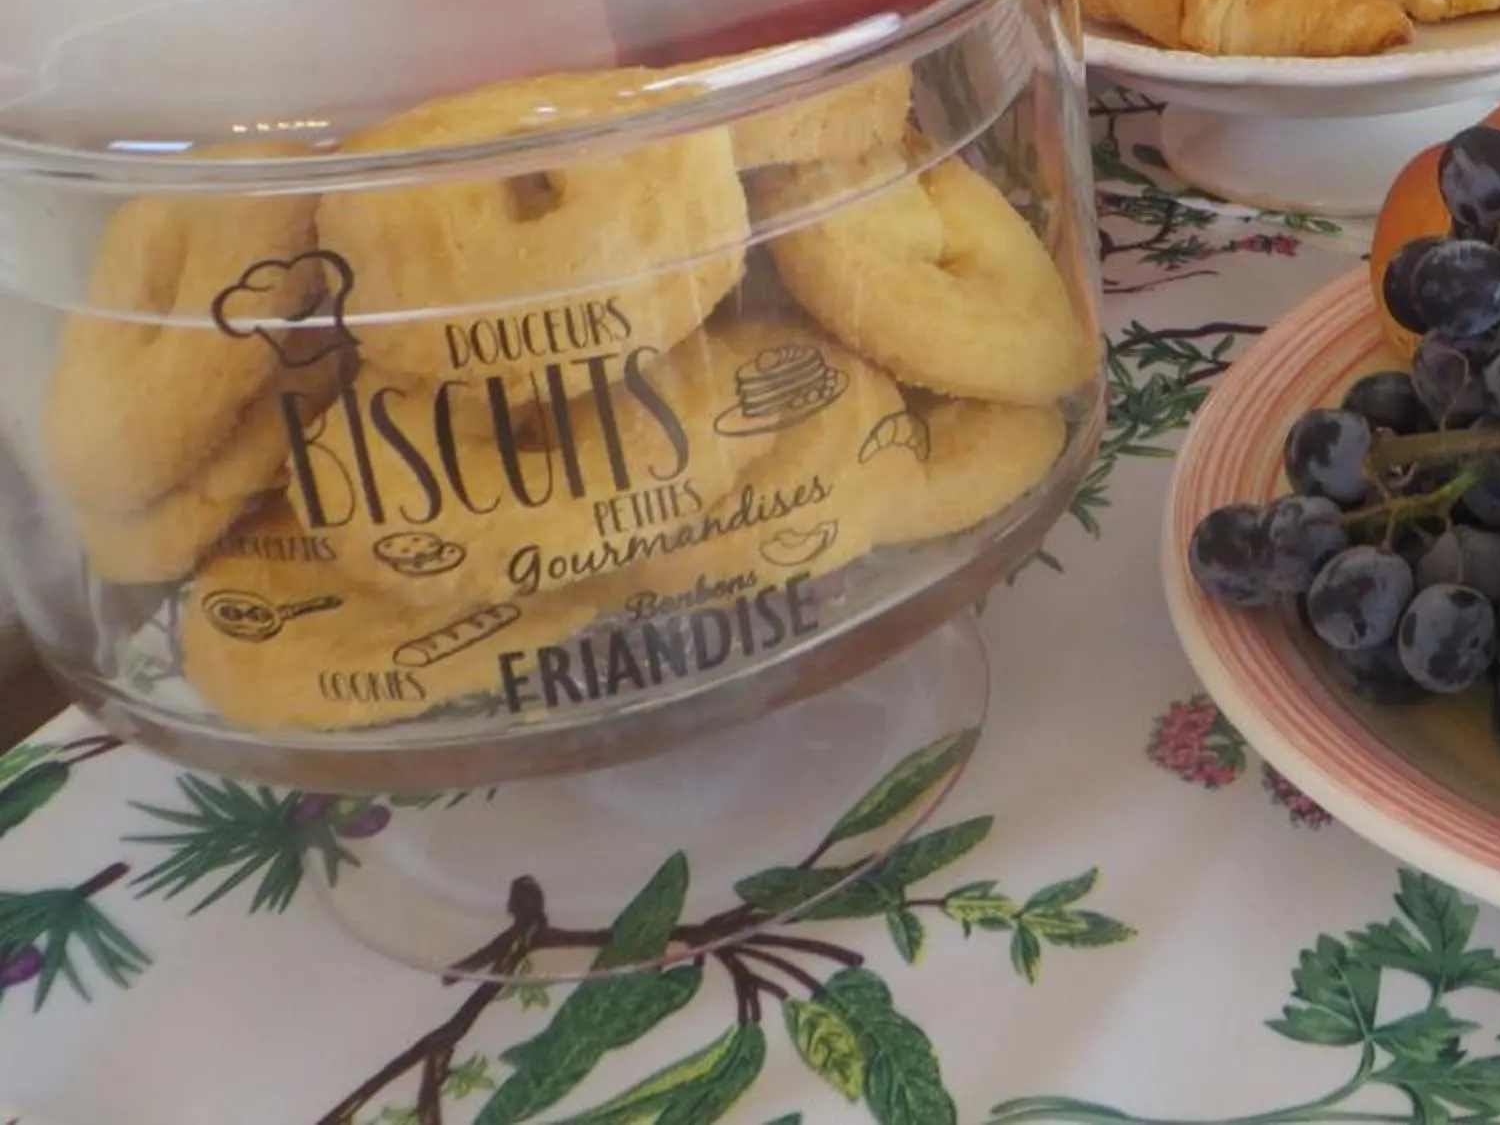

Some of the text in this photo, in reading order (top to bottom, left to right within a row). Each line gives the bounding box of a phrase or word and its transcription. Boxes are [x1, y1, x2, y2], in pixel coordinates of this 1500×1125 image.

[445, 297, 632, 369] DOUCEURS
[282, 346, 690, 529] BISCUITS
[508, 475, 833, 596] Gourmandises
[593, 478, 705, 537] PETITES
[625, 570, 759, 622] Bonbons
[497, 573, 819, 714] FRIANDISE
[318, 670, 426, 702] COOKIES
